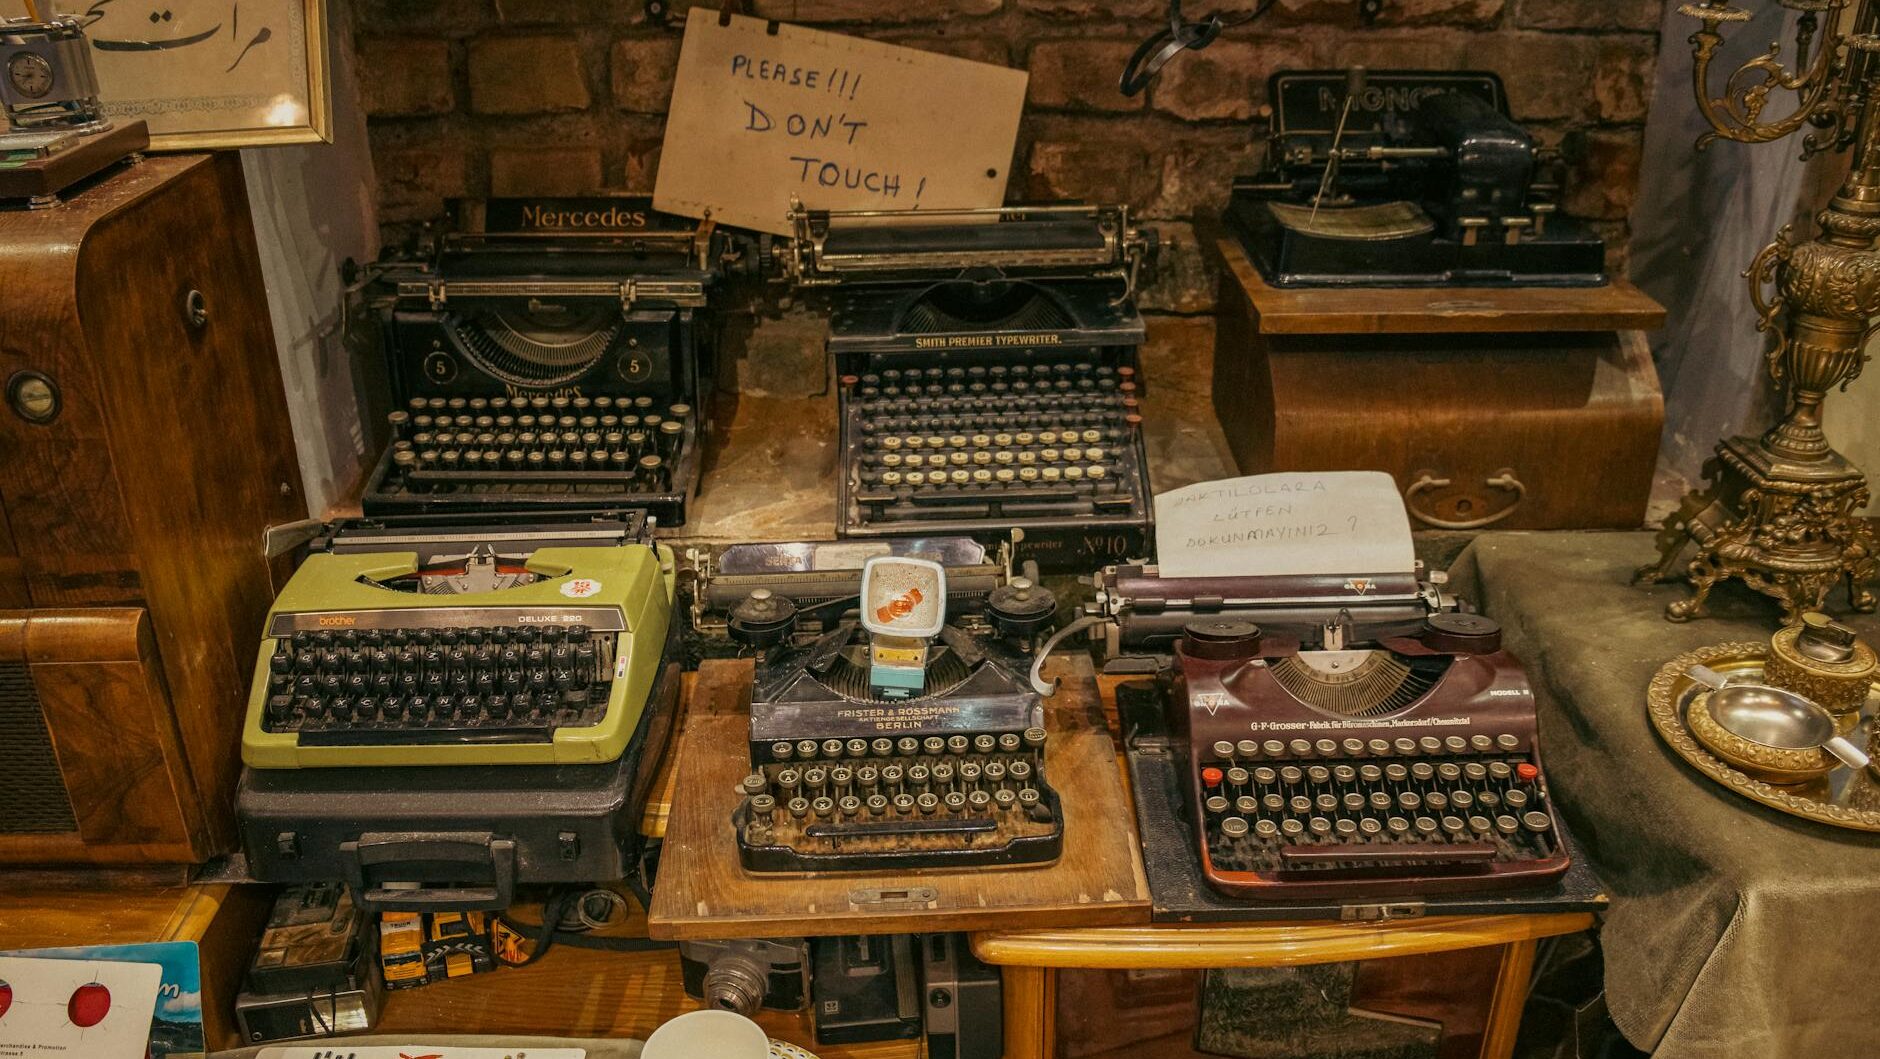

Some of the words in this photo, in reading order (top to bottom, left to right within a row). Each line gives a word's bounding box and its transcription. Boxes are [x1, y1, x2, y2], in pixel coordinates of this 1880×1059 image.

[732, 54, 862, 100] PLEASE!!!
[1317, 86, 1457, 111] MIGNO
[743, 100, 867, 144] DON'T
[790, 157, 901, 197] TOUCH
[521, 204, 646, 228] Mercedes
[915, 337, 946, 348] SMITH
[948, 336, 993, 347] PREMIER
[995, 334, 1063, 346] TYPEWRITER.
[436, 361, 446, 374] 5
[630, 359, 640, 373] 5
[1014, 540, 1063, 552] ypewriter
[1107, 535, 1127, 555] 10
[319, 616, 356, 627] brother
[518, 615, 557, 623] DELUXE
[837, 709, 884, 718] FRISTER
[897, 707, 960, 716] ROSSMANN
[876, 721, 923, 730] BERLIN
